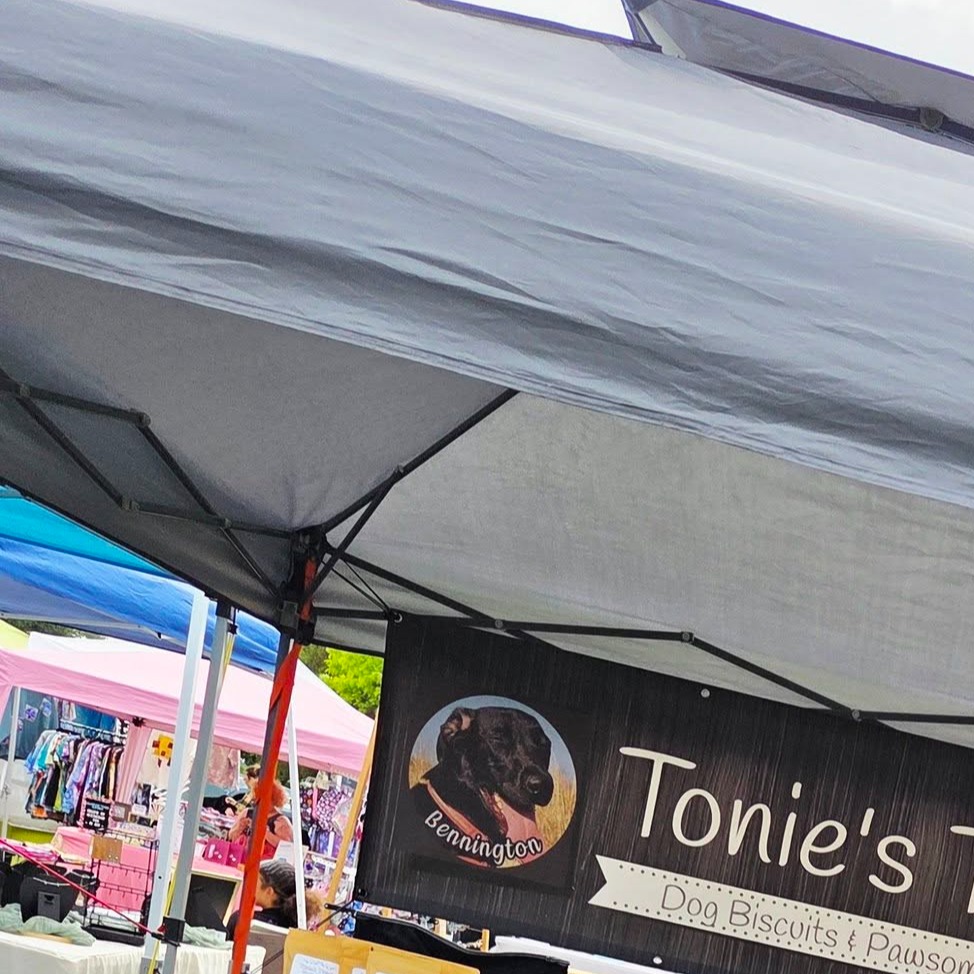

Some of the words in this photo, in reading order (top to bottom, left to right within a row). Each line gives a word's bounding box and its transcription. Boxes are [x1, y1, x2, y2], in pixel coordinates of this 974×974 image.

[425, 810, 542, 865] Bennington
[619, 747, 916, 893] Tonie's
[660, 884, 718, 927] Dog
[729, 899, 838, 948] Biscuits
[848, 930, 857, 951] &
